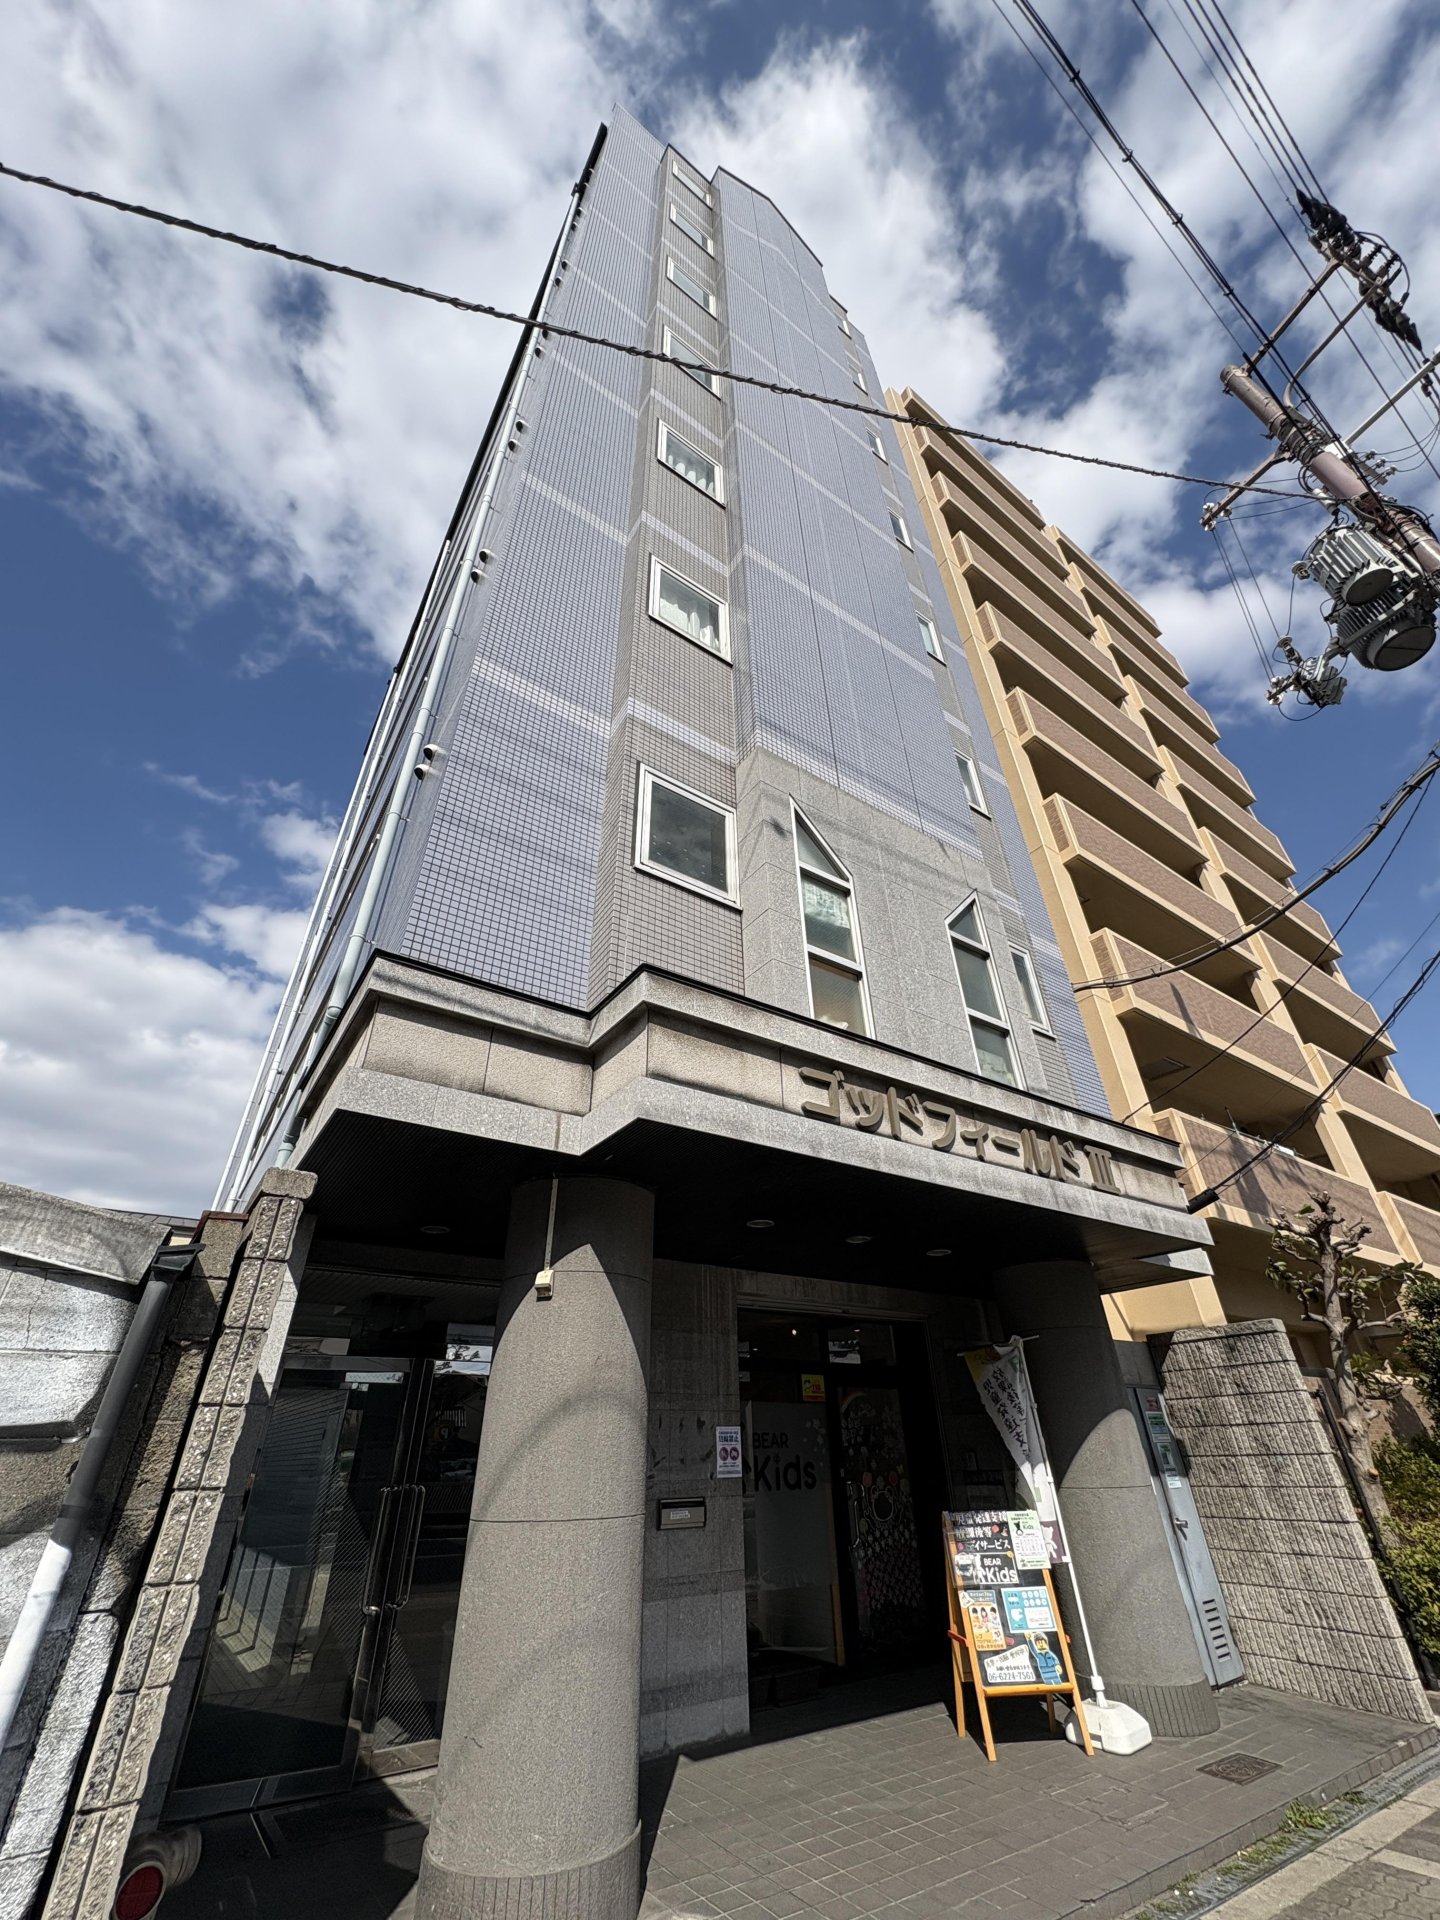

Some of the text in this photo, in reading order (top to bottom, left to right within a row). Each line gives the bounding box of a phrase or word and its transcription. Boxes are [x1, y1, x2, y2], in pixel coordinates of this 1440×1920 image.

[753, 1432, 789, 1449] BEAR
[753, 1453, 818, 1493] Kids
[983, 1558, 1001, 1566] BEAR
[985, 1566, 1018, 1583] Kids
